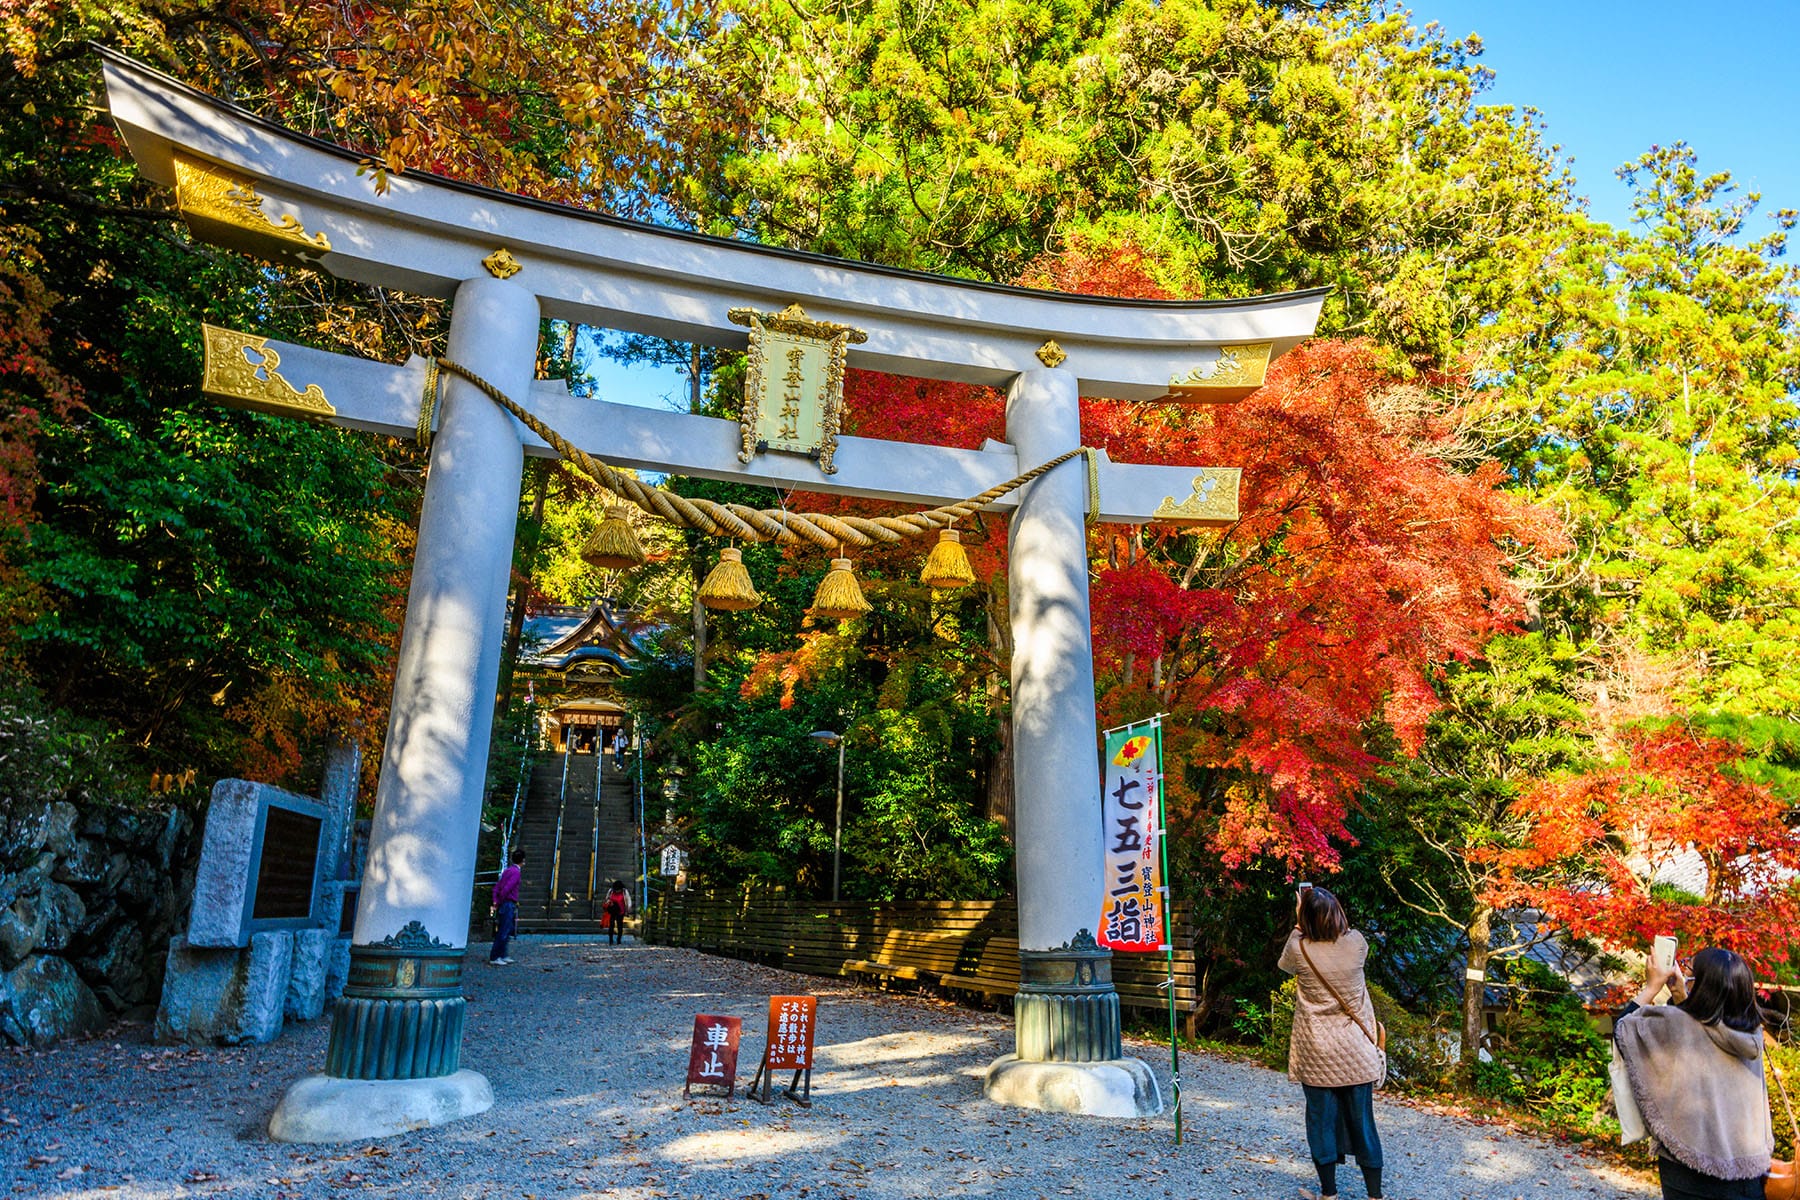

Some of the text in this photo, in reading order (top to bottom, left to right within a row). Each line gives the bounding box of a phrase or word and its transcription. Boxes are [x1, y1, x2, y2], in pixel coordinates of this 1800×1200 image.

[1106, 775, 1144, 943] 七五三詣
[700, 1023, 729, 1078] 車止
